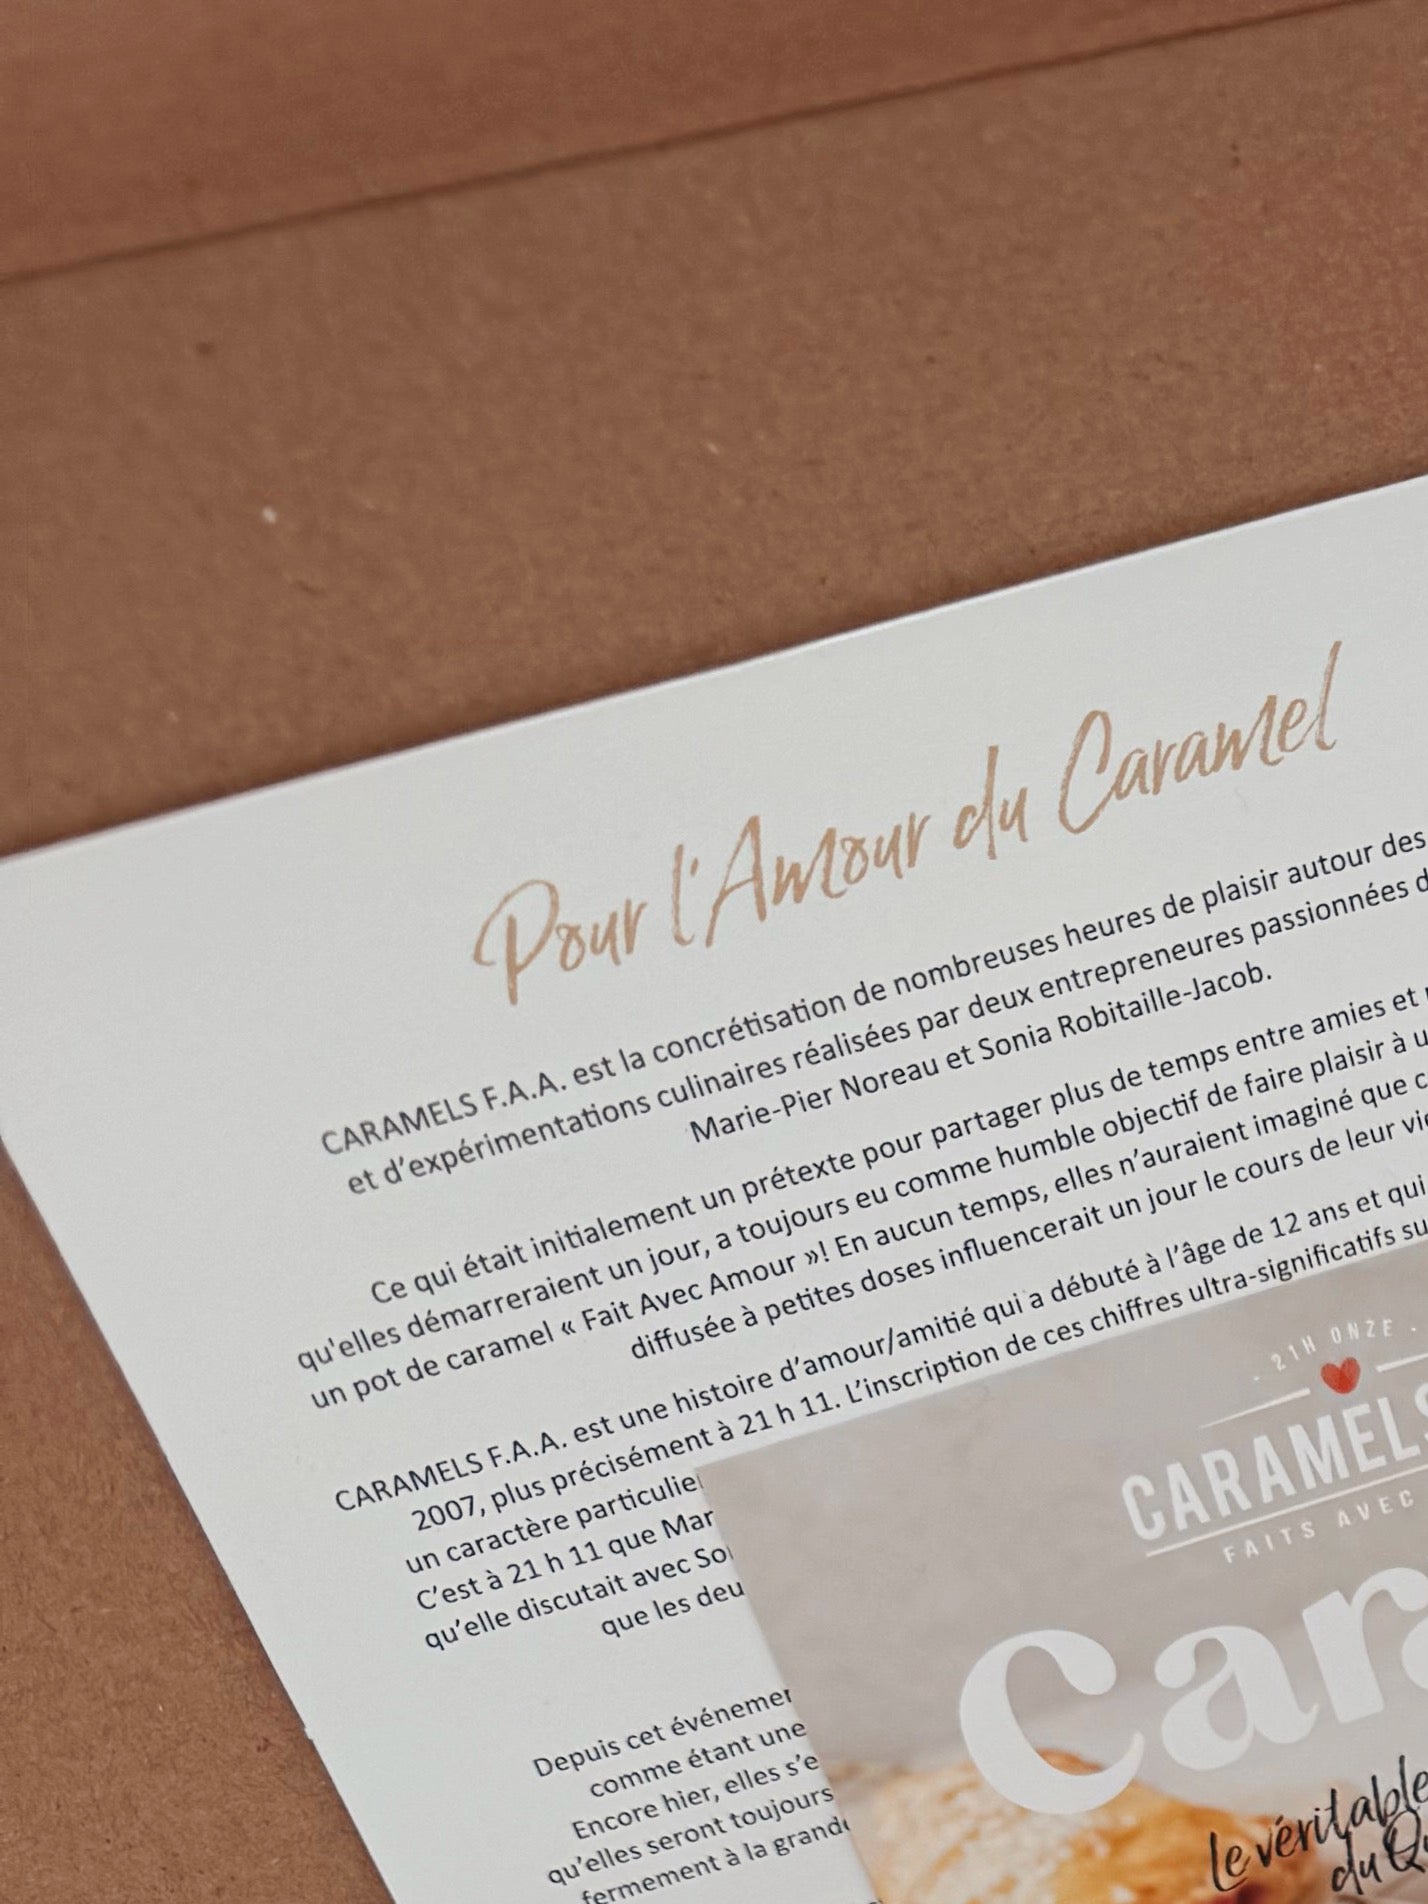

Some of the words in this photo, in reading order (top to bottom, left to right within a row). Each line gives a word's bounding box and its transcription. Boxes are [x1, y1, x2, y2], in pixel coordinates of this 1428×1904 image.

[472, 878, 648, 1006] Pour
[952, 745, 1029, 861] du
[1058, 640, 1342, 836] Caramel
[320, 1092, 479, 1156] CARAMELS
[480, 1071, 568, 1112] F.A.A.
[572, 1055, 618, 1087] est
[617, 1047, 647, 1074] la
[651, 994, 848, 1064] concrétisation
[852, 979, 888, 1007] de
[892, 933, 1060, 997] nombreuses
[1061, 906, 1157, 948] heures
[1161, 892, 1196, 920] de
[1200, 868, 1280, 916] plaisir
[1286, 844, 1374, 886] autour
[1380, 830, 1427, 859] des
[688, 1086, 834, 1144] Marie-Pier
[838, 1057, 941, 1102] Noreau
[945, 1044, 976, 1071] et
[977, 1023, 1053, 1061] Sonia
[1056, 960, 1273, 1039] Robitaille-Jacob.
[630, 1314, 738, 1360] diffusée
[740, 1304, 760, 1328] à
[763, 1281, 856, 1327] petites
[860, 1257, 936, 1293] doses
[937, 1205, 1105, 1271] influencerait
[1108, 1197, 1143, 1221] un
[1145, 1179, 1199, 1216] jour
[1202, 1169, 1229, 1193] le
[1234, 1149, 1305, 1184] cours
[1309, 1136, 1342, 1163] de
[1344, 1121, 1396, 1152] leur
[1270, 1335, 1317, 1374] 21H
[1329, 1317, 1395, 1346] ONZE
[1223, 1519, 1317, 1564] FAITS
[1336, 1489, 1415, 1529] AVEC
[589, 1759, 684, 1799] comme
[687, 1735, 757, 1770] étant
[757, 1722, 808, 1748] une
[547, 1844, 644, 1887] qu’elles
[645, 1817, 729, 1856] seront
[728, 1787, 835, 1830] toujours
[1330, 1831, 1381, 1895] du
